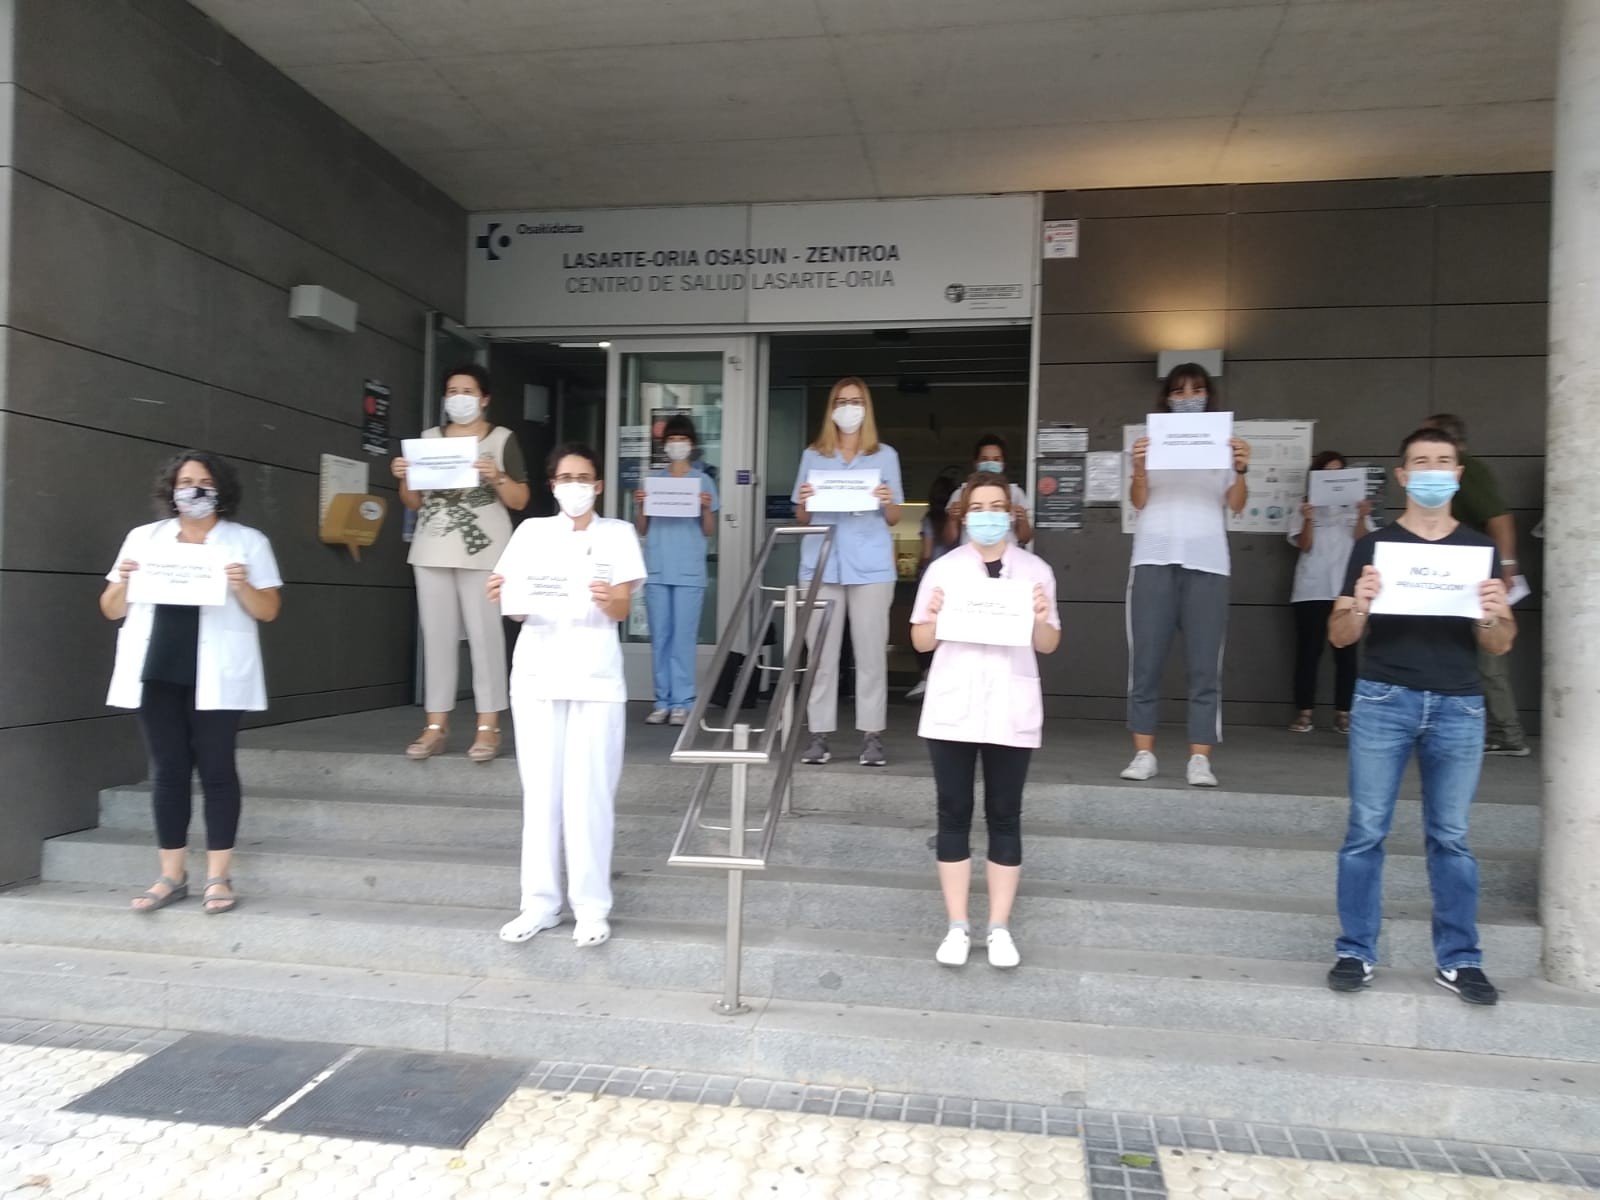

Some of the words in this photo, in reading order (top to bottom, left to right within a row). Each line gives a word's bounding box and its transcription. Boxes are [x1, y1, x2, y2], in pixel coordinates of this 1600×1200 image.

[516, 223, 584, 234] Osakidetza
[562, 250, 700, 269] LASARTE-ORIA
[704, 248, 787, 266] OSASUN
[806, 244, 900, 263] ZENTROA
[565, 275, 643, 293] CENTRO
[648, 275, 674, 291] DE
[680, 273, 746, 291] SALUD
[752, 270, 895, 289] LASARTE-ORIA
